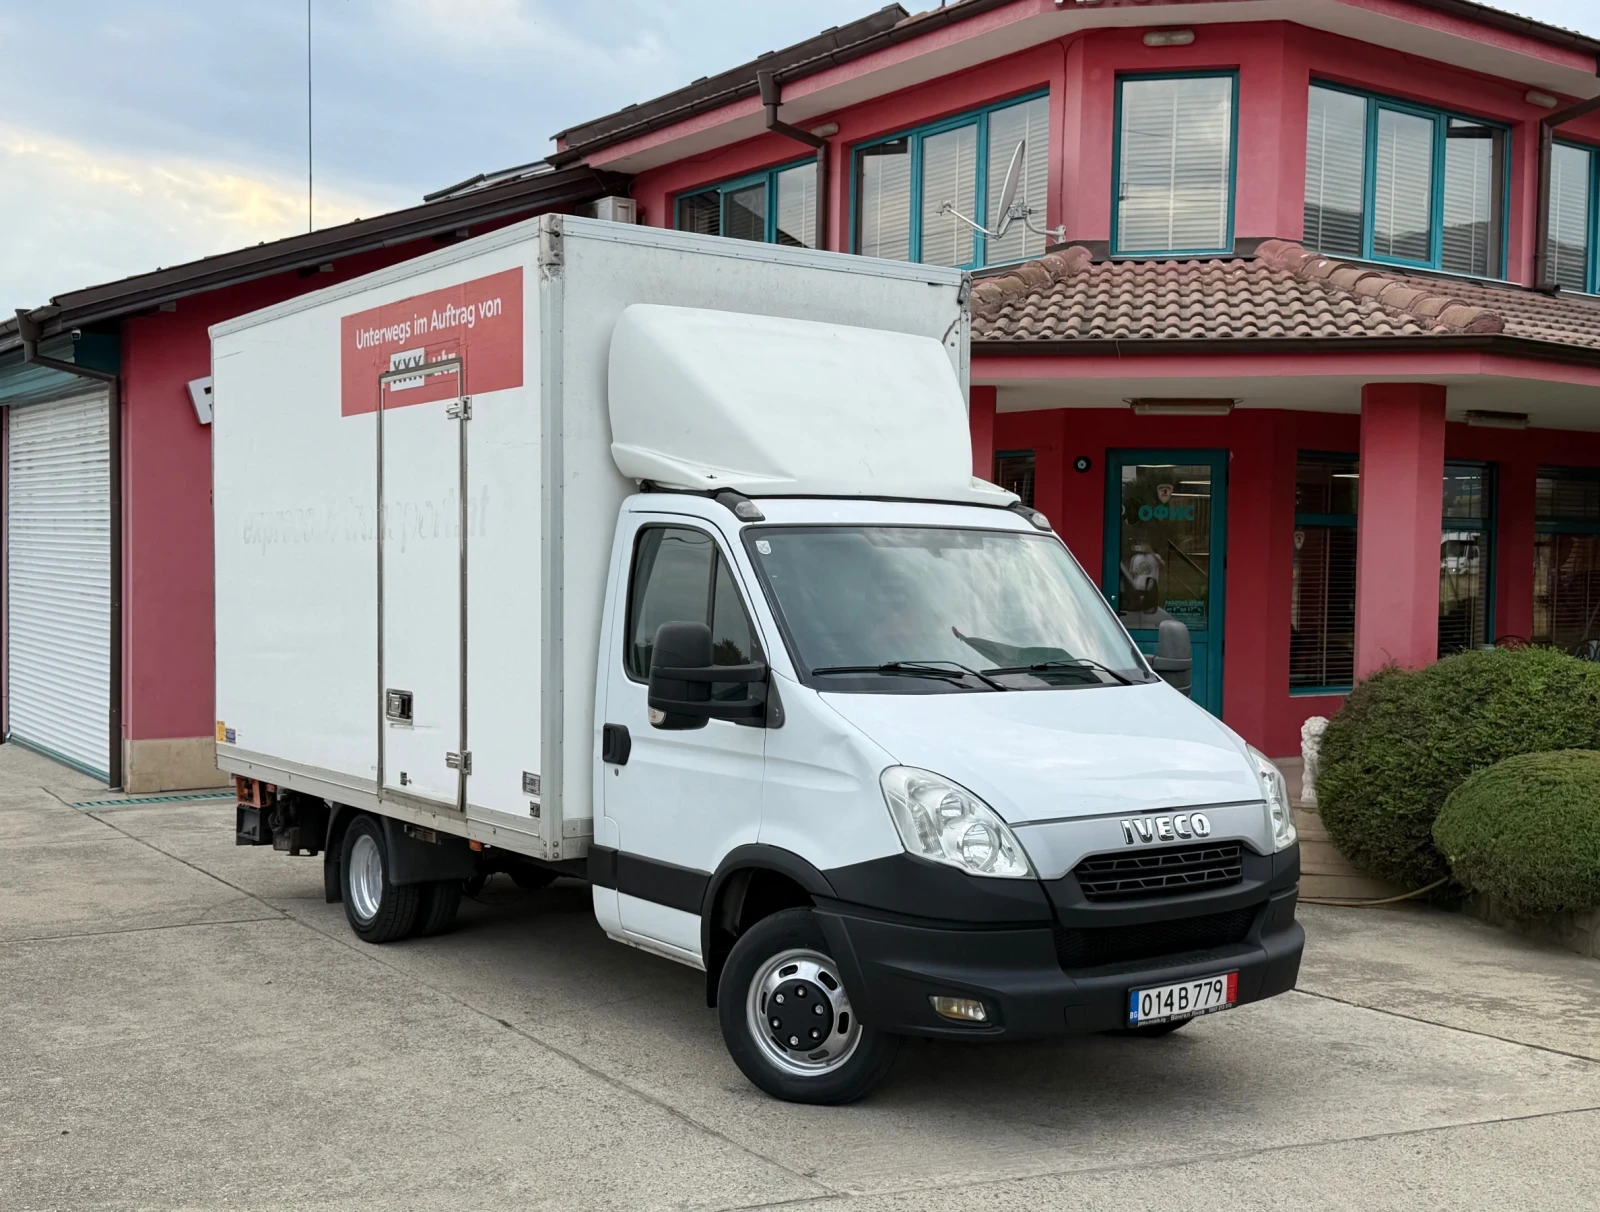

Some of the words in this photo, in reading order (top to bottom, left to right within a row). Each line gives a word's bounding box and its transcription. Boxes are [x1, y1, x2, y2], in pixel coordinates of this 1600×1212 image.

[356, 320, 411, 349] Unterwegs
[414, 314, 428, 335] im
[430, 303, 476, 332] Auftrag
[479, 297, 502, 320] von
[1138, 505, 1195, 521] ОФИС
[1120, 812, 1211, 845] IVECO
[1130, 1010, 1138, 1020] BG
